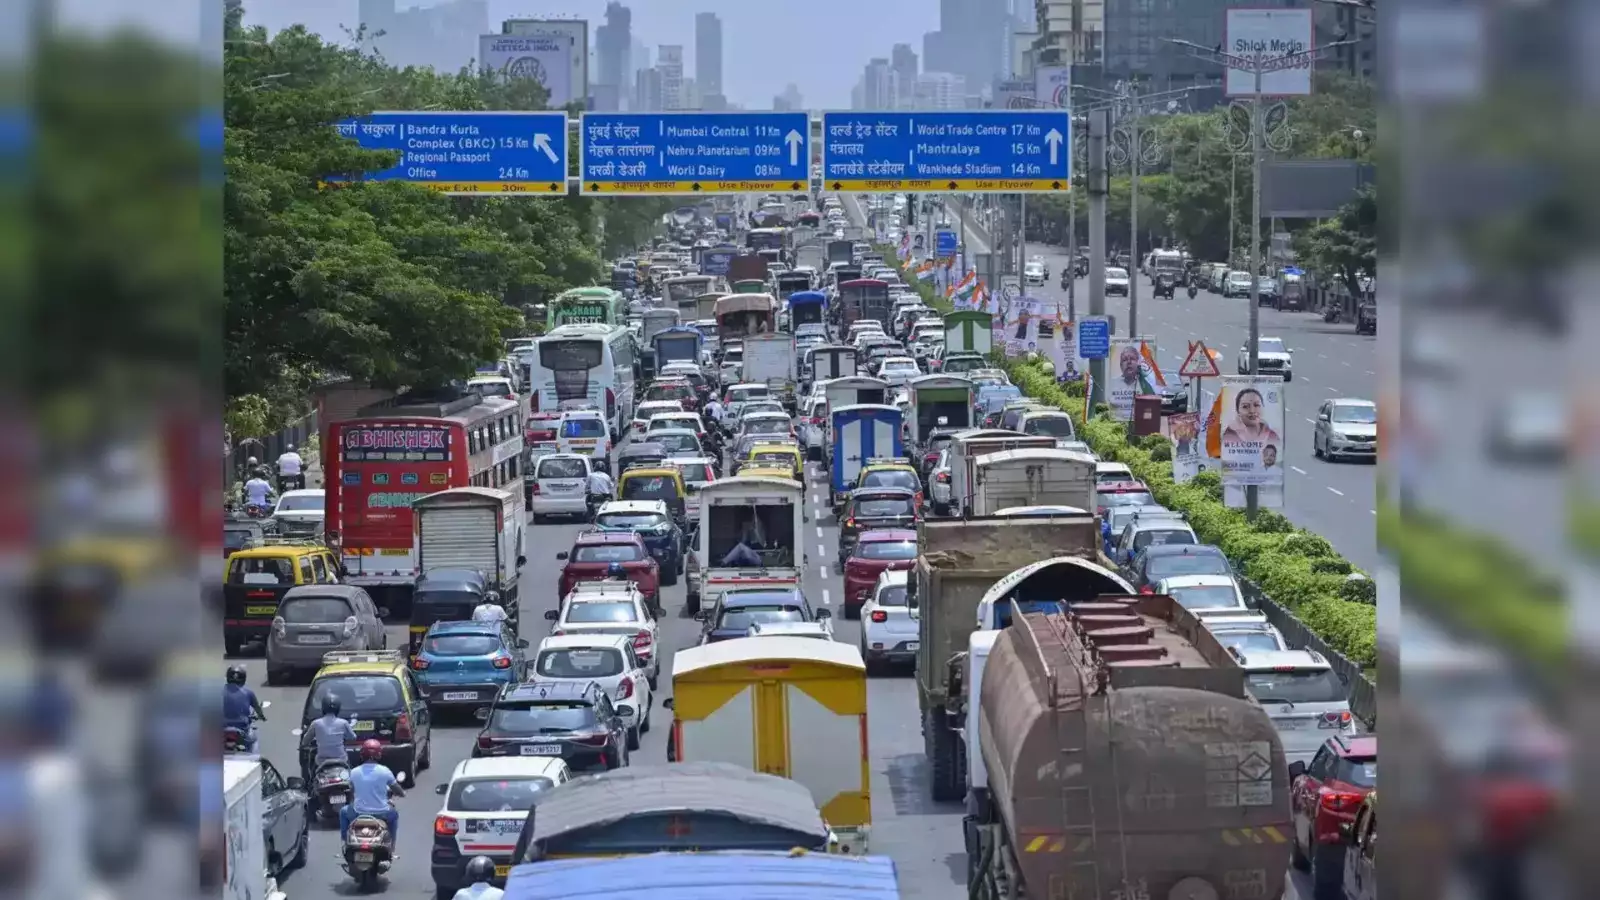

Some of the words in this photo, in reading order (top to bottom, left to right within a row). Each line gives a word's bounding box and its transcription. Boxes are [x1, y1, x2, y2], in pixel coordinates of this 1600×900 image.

[1236, 39, 1267, 51] Shlok
[1270, 39, 1302, 51] Media
[361, 122, 396, 138] संकुल
[407, 124, 446, 135] Bandra
[450, 124, 479, 135] Kurla
[588, 122, 611, 140] मुंबई
[667, 126, 708, 137] Mumbai
[711, 126, 749, 137] Central
[830, 121, 852, 136] वर्ल्ड
[856, 121, 871, 139] ट्रेड
[876, 121, 898, 136] सेंटर
[917, 124, 944, 135] World
[947, 124, 973, 135] Trade
[976, 124, 1006, 135] Centre
[1011, 124, 1022, 135] 17
[1027, 124, 1040, 135] Km
[407, 138, 455, 150] Complex
[458, 138, 495, 150] (BKC)
[500, 138, 513, 148] 1.5
[515, 138, 529, 148] Km
[589, 141, 614, 157] नेहरू
[617, 142, 655, 156] तारांगण
[830, 140, 864, 155] मंत्रालय
[917, 143, 980, 156] Mantralaya
[1011, 143, 1023, 154] 15
[1027, 143, 1040, 154] Km
[667, 146, 694, 156] Nehru
[697, 146, 750, 156] Planetarium
[407, 152, 448, 165] Regional
[450, 152, 490, 164] Passport
[407, 167, 437, 178] Office
[499, 168, 513, 179] 2.4
[515, 167, 529, 178] Km
[588, 162, 615, 176] वरळी
[618, 161, 647, 176] डेअरी
[667, 165, 695, 175] Worli
[698, 165, 725, 177] Dairy
[830, 161, 864, 176] वानखेडे
[917, 163, 962, 174] Wankhede
[965, 163, 1001, 174] Stadium
[1011, 163, 1023, 174] 14
[1027, 163, 1040, 174] Km
[502, 184, 526, 192] 30m
[740, 182, 774, 191] Flyover
[999, 181, 1033, 189] Flyover
[346, 430, 445, 449] ABHISHEK
[367, 492, 431, 508] ABHISH
